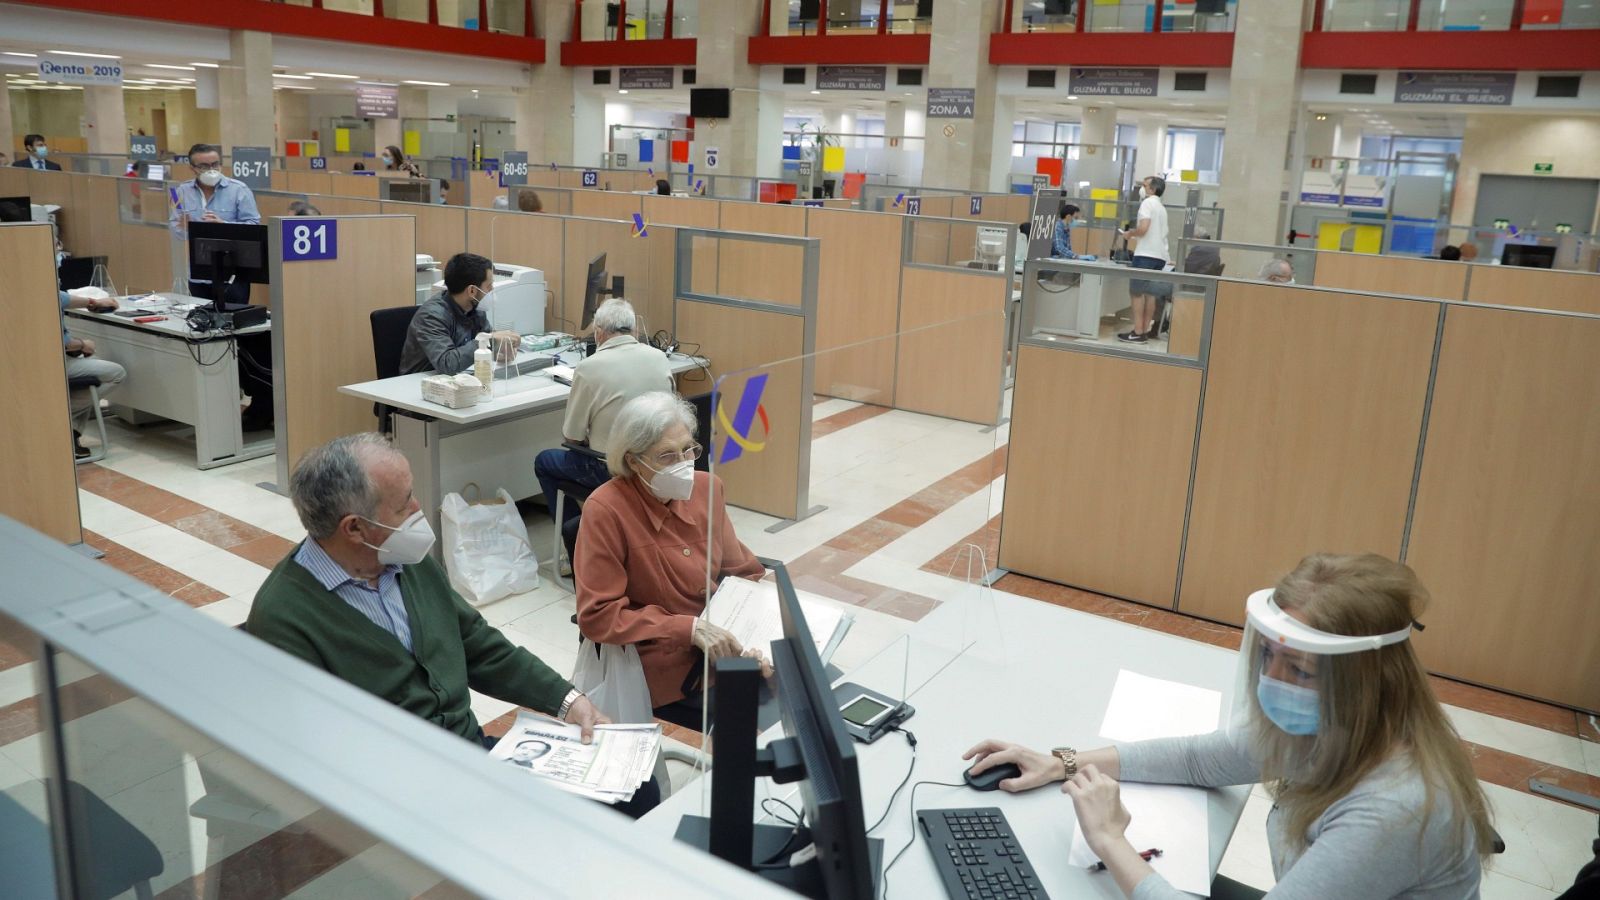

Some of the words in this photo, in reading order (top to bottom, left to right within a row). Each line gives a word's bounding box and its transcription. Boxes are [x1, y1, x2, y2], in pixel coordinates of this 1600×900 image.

[40, 60, 85, 75] Renta
[93, 65, 121, 77] 2019
[1124, 87, 1152, 95] BUENO
[1448, 94, 1462, 102] EL
[1467, 94, 1506, 103] BUENO
[930, 105, 959, 115] ZONA
[963, 105, 972, 115] A
[233, 161, 269, 177] 66-71
[313, 158, 324, 168] 50
[504, 162, 528, 176] 60-65
[584, 173, 595, 185] 62
[909, 200, 919, 215] 73
[972, 199, 980, 213] 74
[1031, 214, 1056, 240] 78-81
[293, 224, 326, 255] 81
